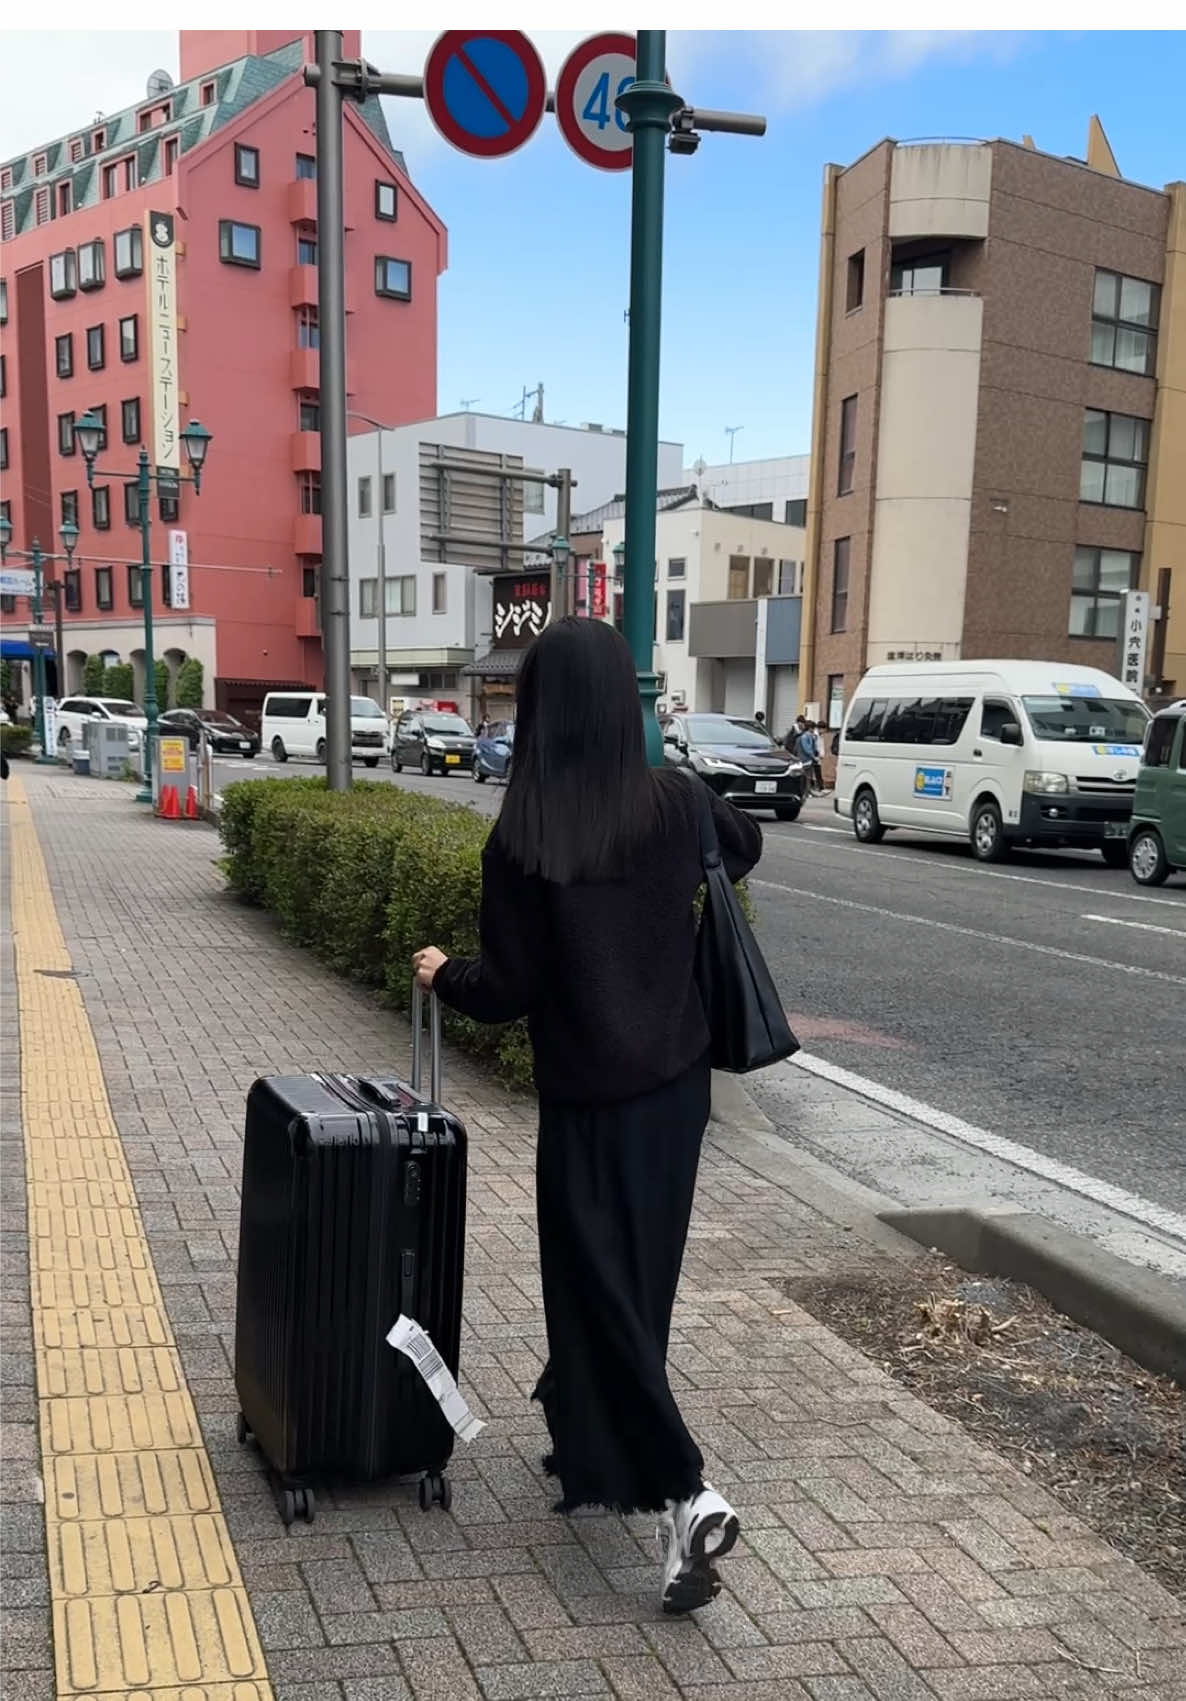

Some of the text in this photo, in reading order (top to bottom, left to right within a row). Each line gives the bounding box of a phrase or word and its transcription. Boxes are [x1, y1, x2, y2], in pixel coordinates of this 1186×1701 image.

[156, 255, 175, 460] ホテルニューステーション
